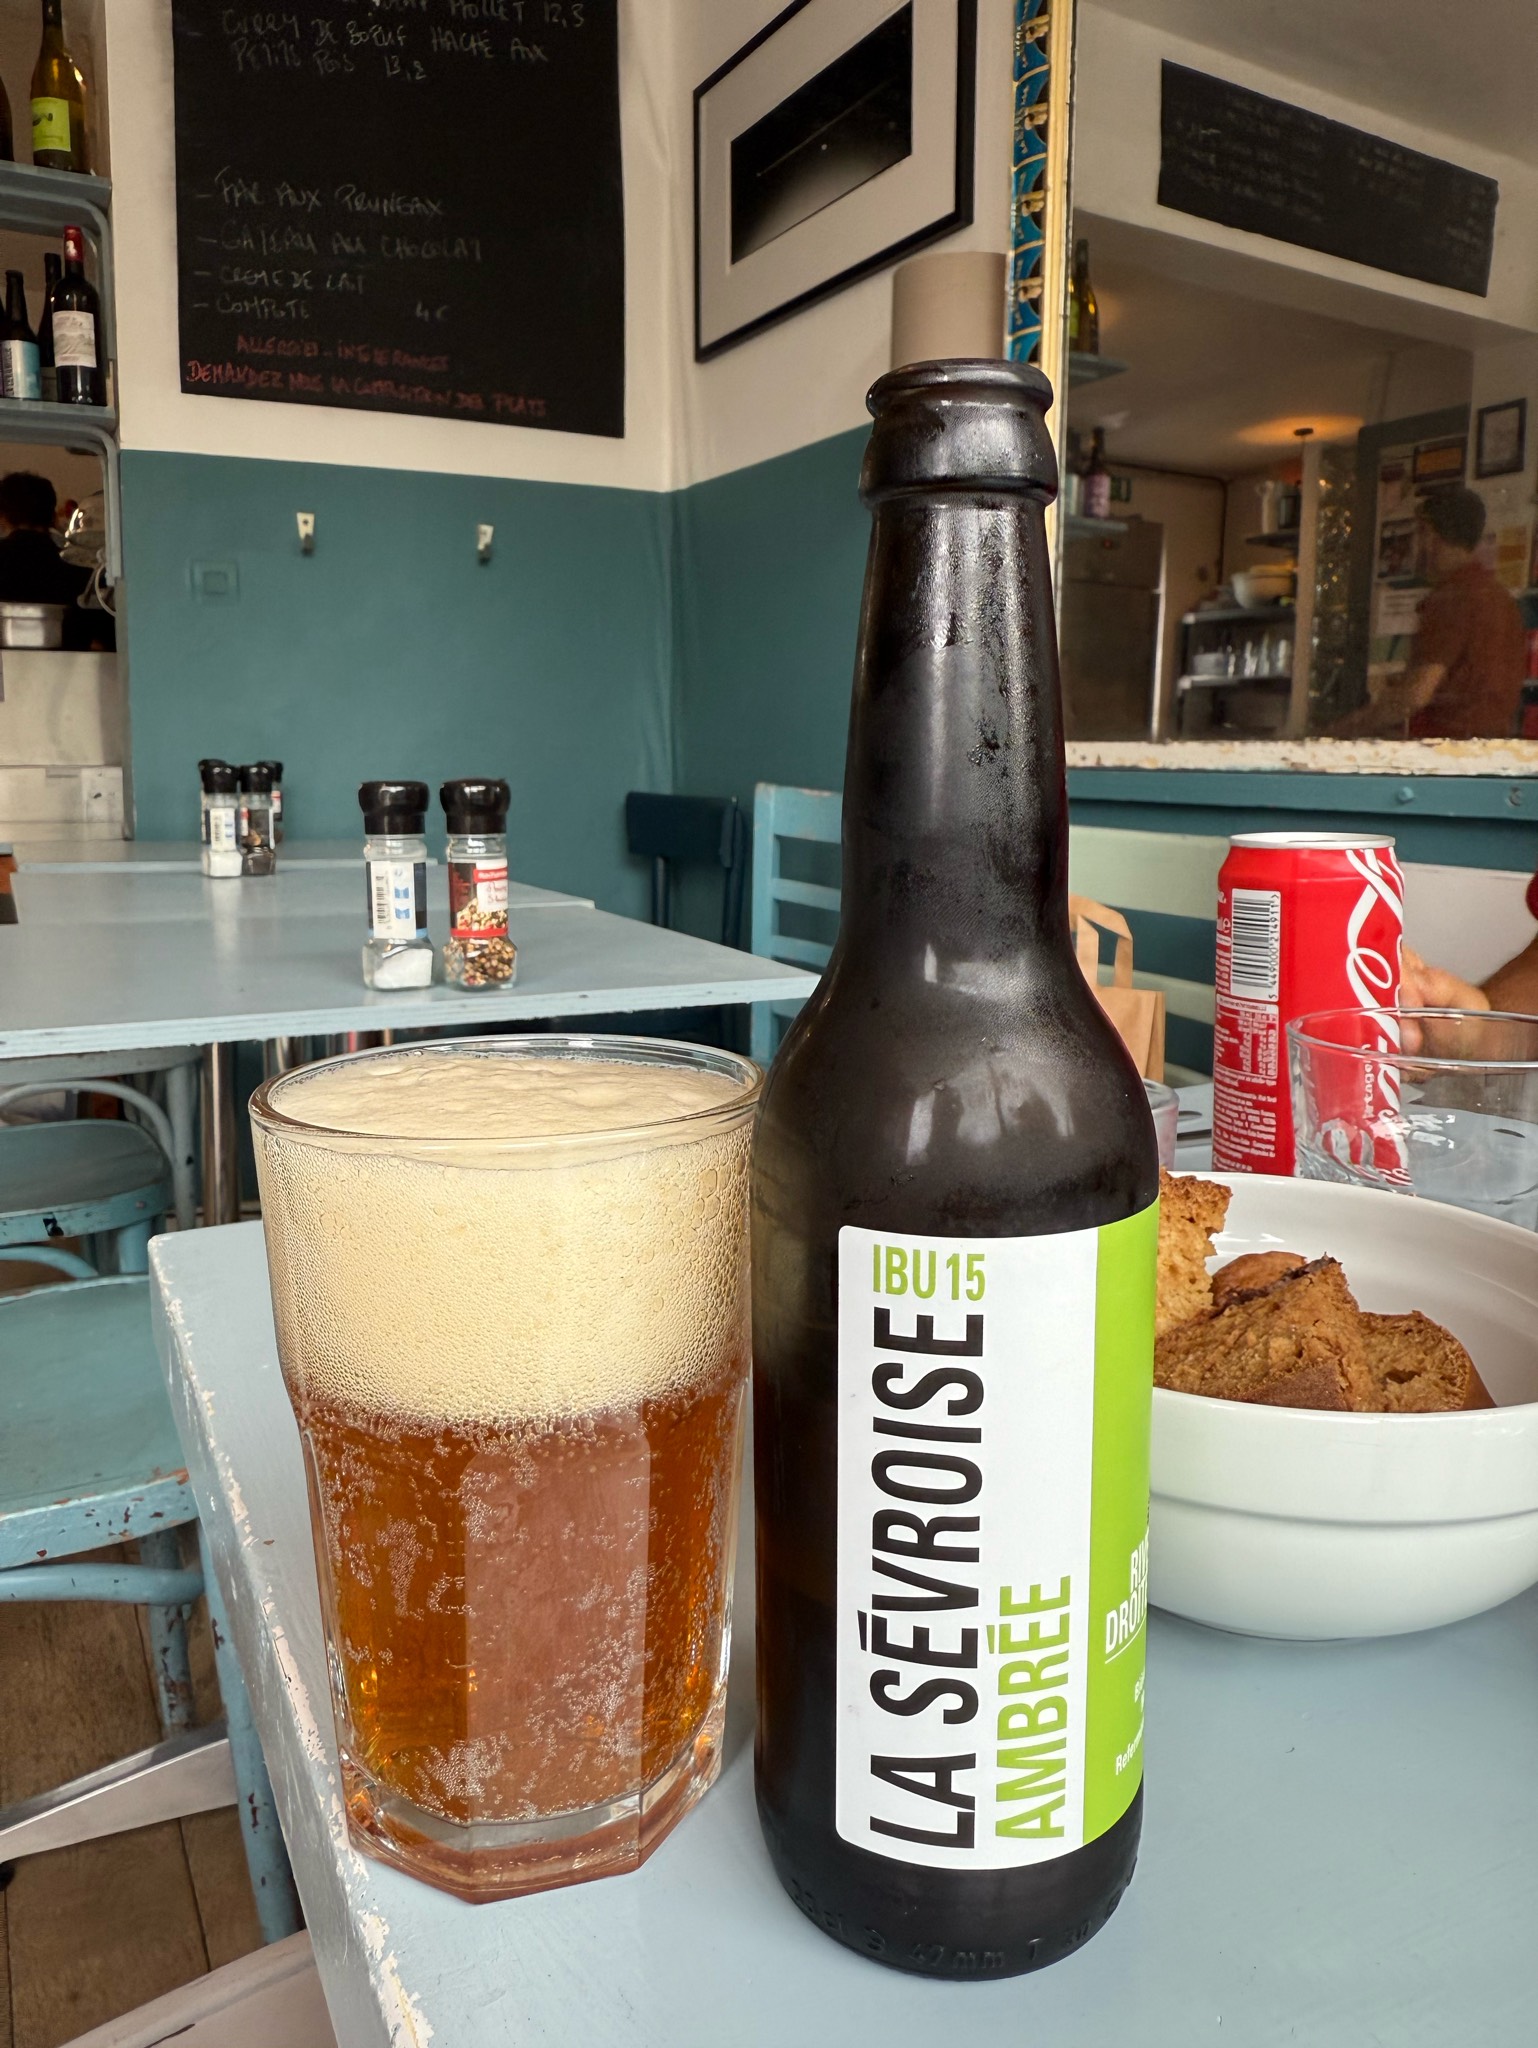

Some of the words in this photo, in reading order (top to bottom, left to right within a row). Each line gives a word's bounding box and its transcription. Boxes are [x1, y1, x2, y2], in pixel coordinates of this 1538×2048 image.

[872, 1244, 937, 1300] IBU
[945, 1252, 986, 1302] 15
[857, 1306, 985, 1725] SÉVROISE
[1130, 1526, 1149, 1594] RIV
[1105, 1575, 1149, 1655] DROIT
[986, 1575, 1071, 1839] AMBRÉE
[869, 1752, 977, 1849] LA
